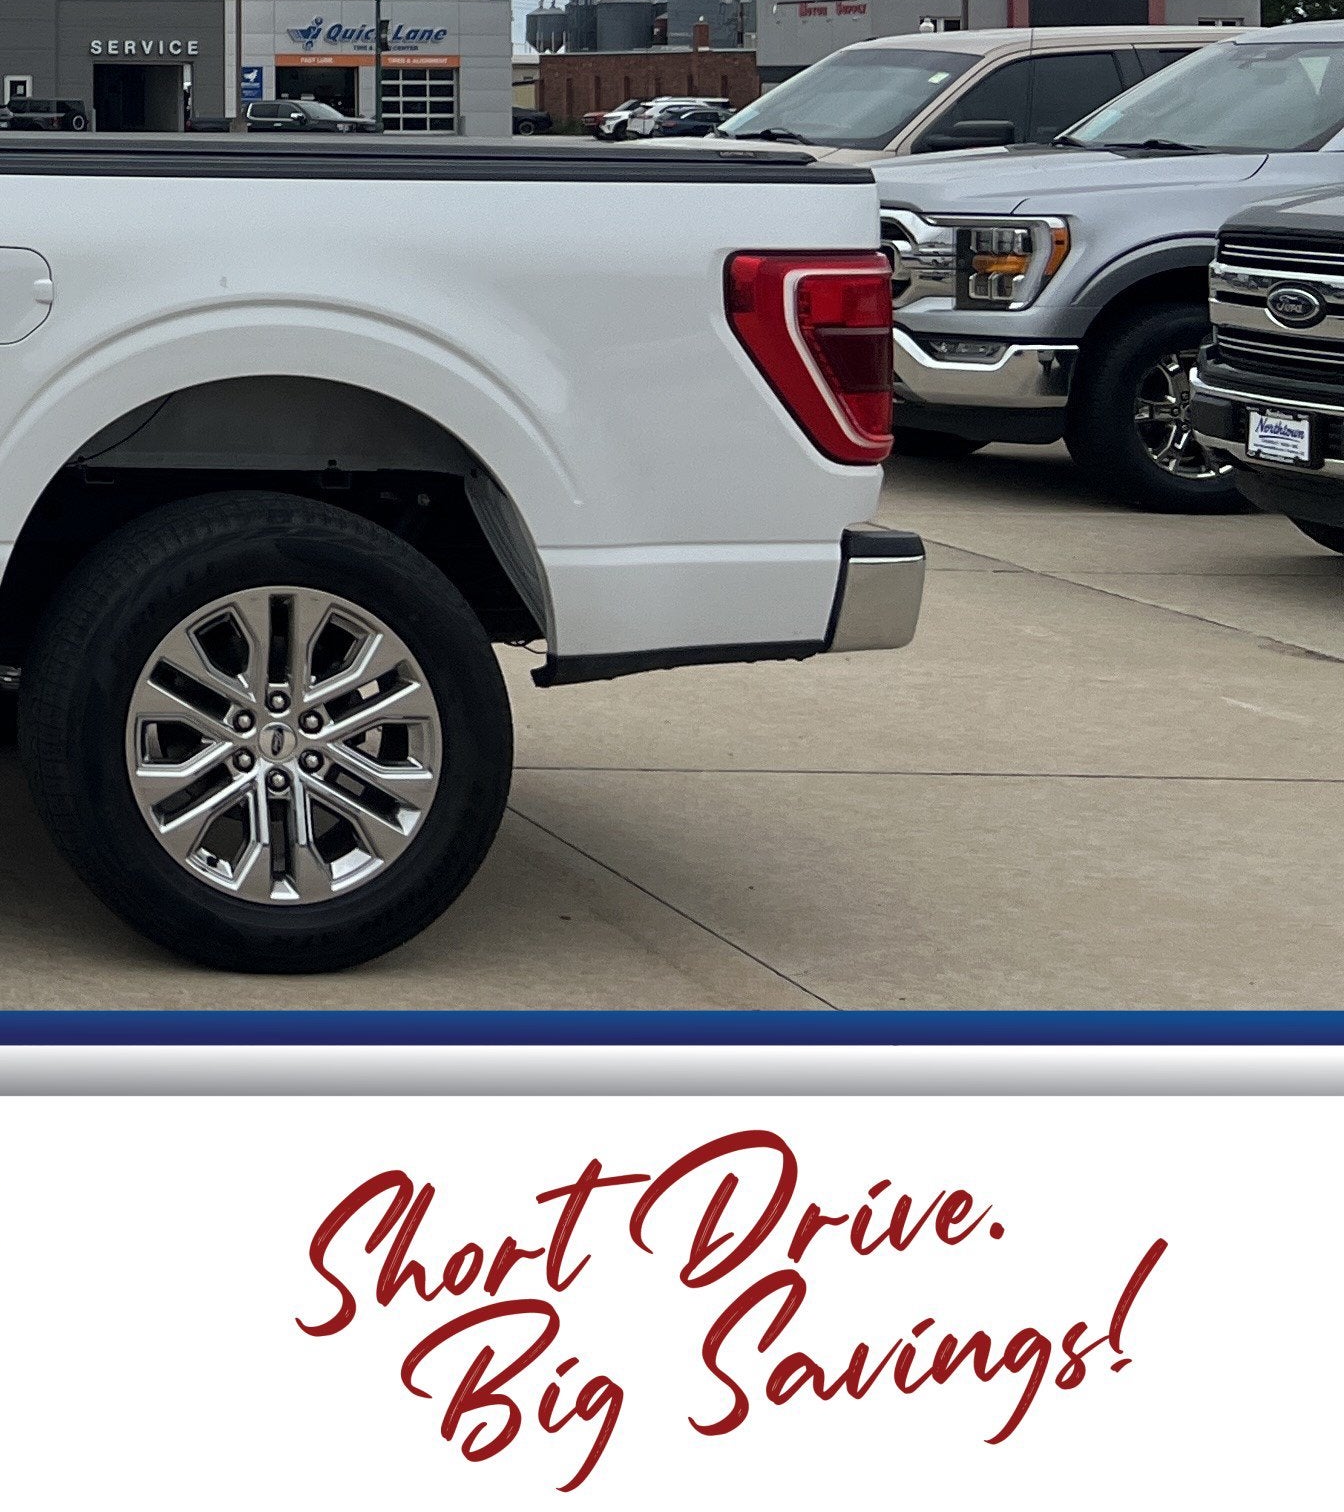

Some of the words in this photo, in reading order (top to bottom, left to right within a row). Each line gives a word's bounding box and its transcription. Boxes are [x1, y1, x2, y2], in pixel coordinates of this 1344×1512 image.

[392, 24, 448, 41] Lane
[90, 39, 199, 55] SERVICE
[1276, 294, 1303, 313] Ford
[1255, 415, 1305, 439] Northtown
